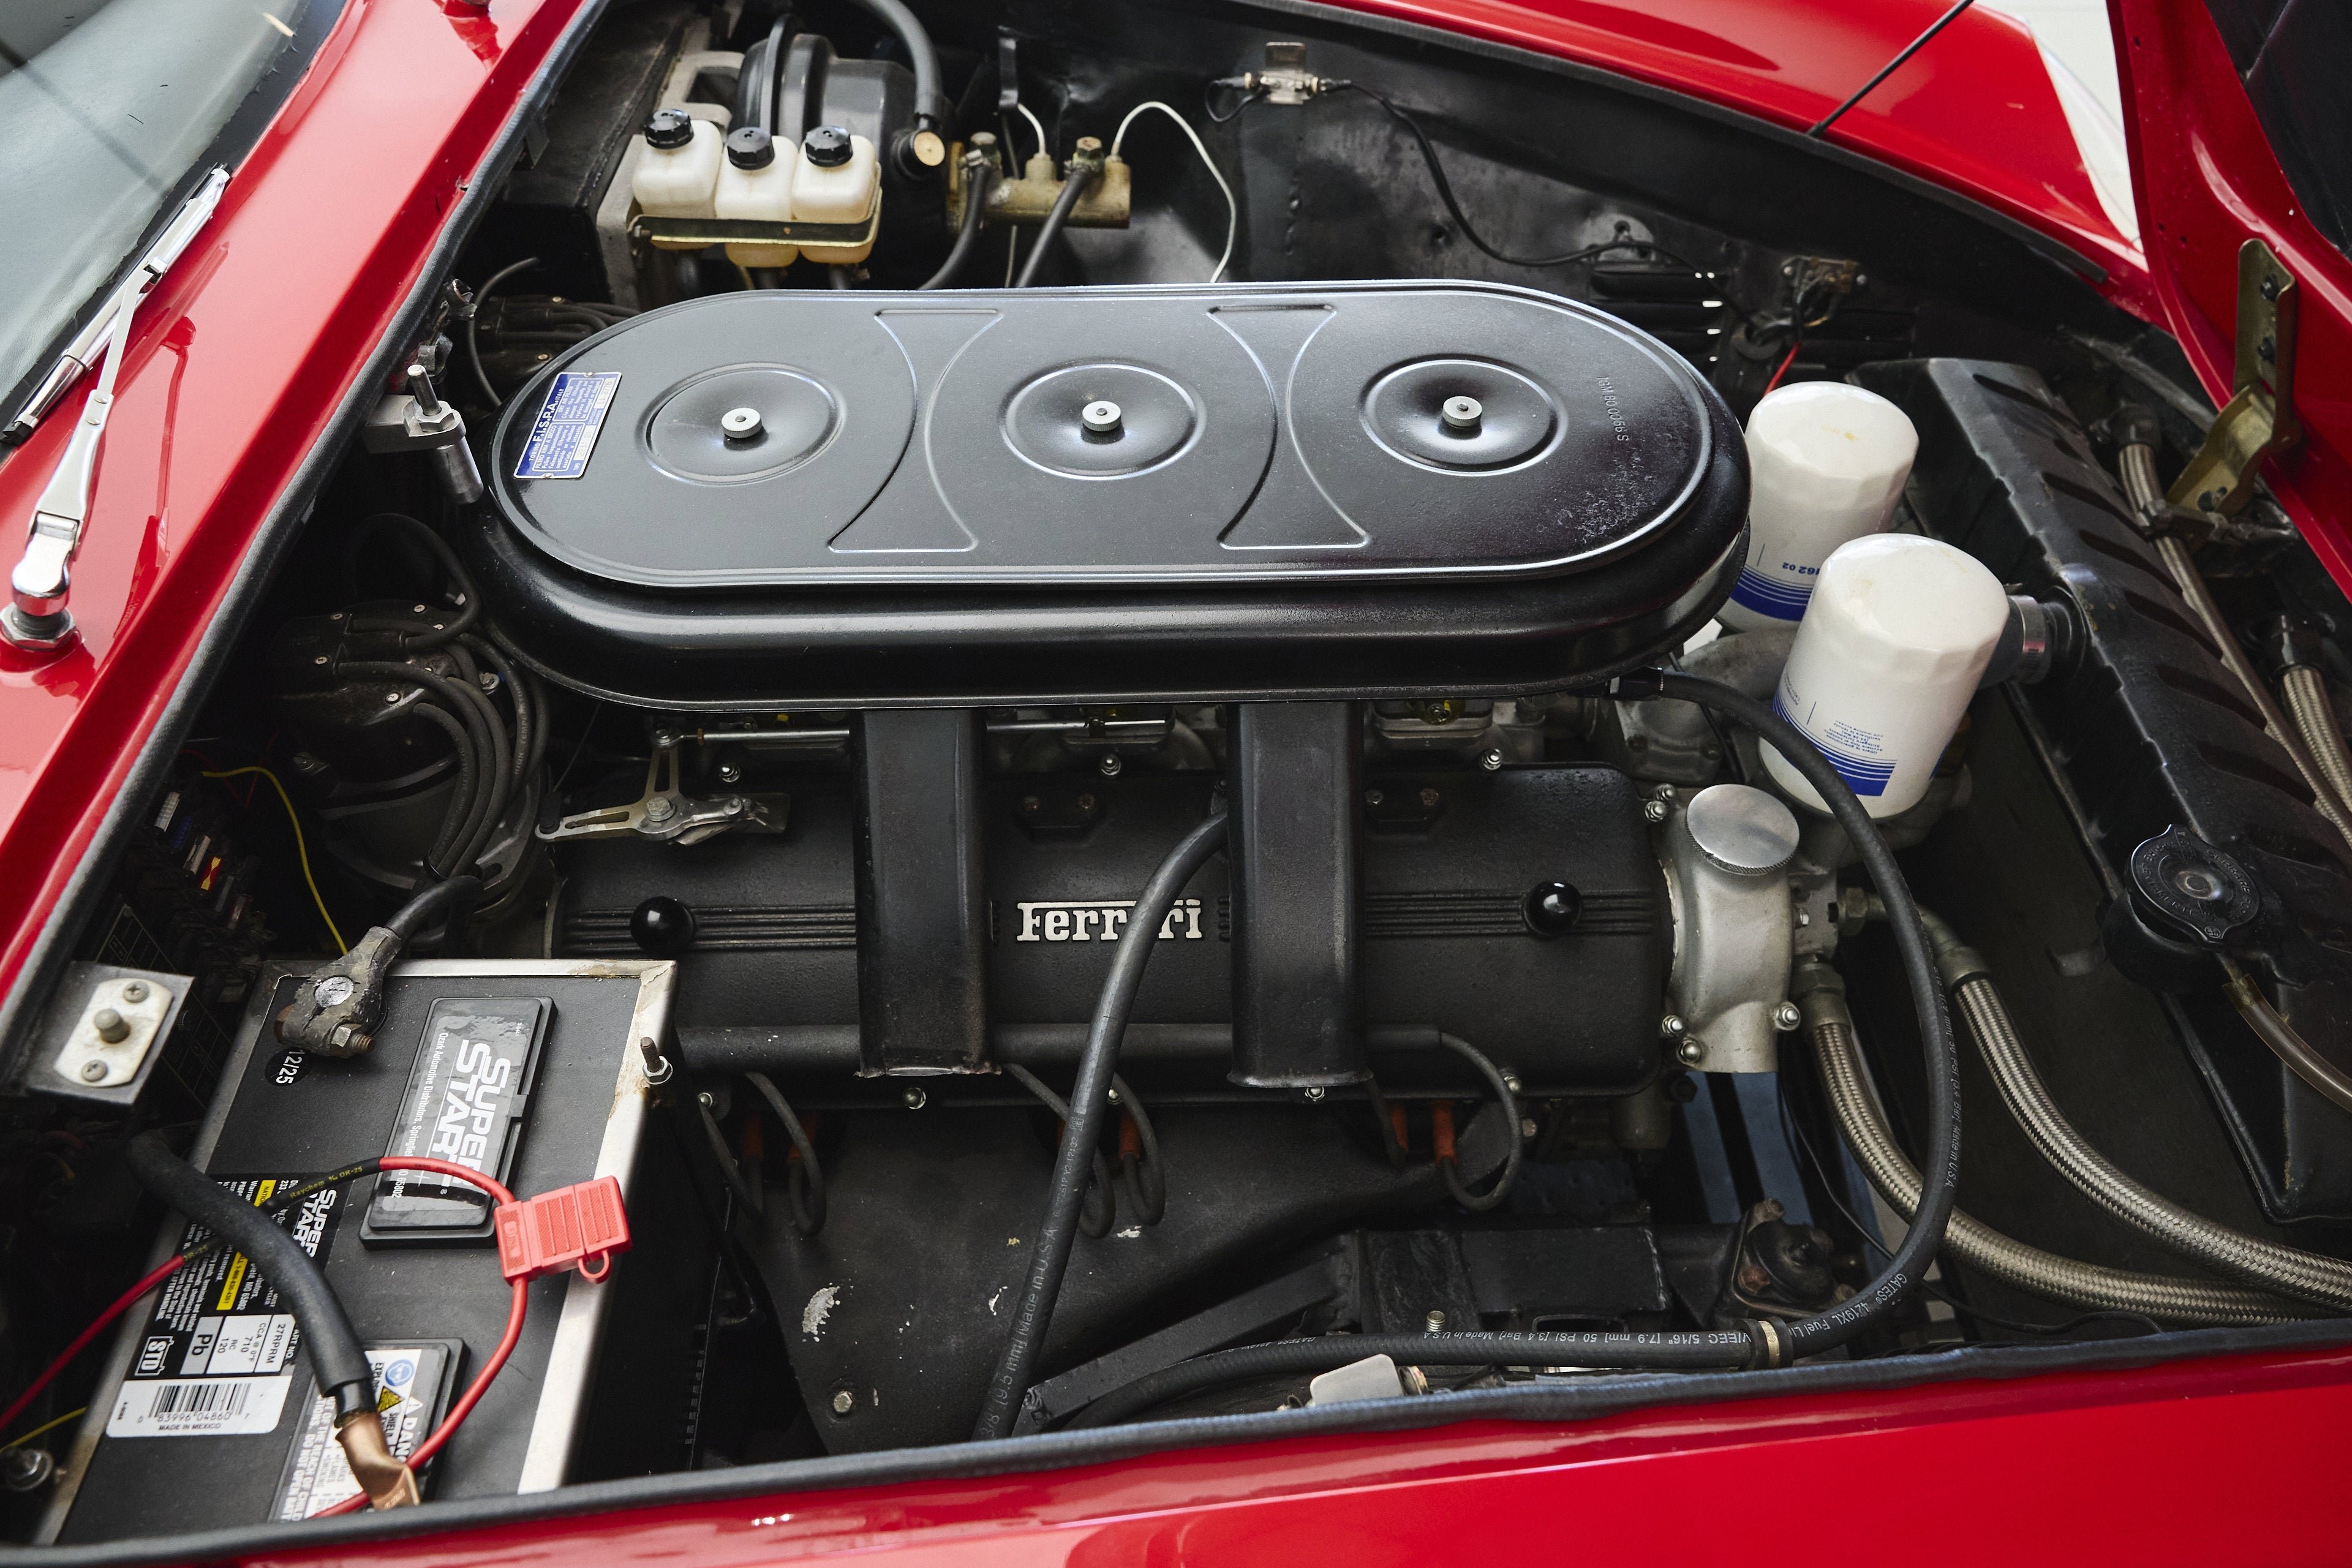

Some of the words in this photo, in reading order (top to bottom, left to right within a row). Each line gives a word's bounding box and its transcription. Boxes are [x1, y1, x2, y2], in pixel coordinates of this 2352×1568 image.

[529, 443, 541, 461] TORINO
[554, 388, 564, 400] ITALY
[1016, 899, 1202, 941] Ferrri
[434, 1033, 448, 1049] Ozark
[276, 1049, 305, 1084] 12/25
[424, 1050, 443, 1084] Automotive
[412, 1085, 432, 1124] Distributors,
[455, 1057, 511, 1186] SUPER
[402, 1125, 421, 1156] Springfiel
[278, 1180, 288, 1189] 233
[391, 1177, 406, 1197] 65802
[214, 1254, 231, 1282] removed.
[243, 1282, 254, 1291] MO
[236, 1292, 250, 1310] 65802
[269, 1293, 278, 1306] MUST
[192, 1303, 202, 1313] and
[255, 1322, 266, 1338] CCA
[1804, 1319, 1830, 1335] Fuel
[265, 1324, 285, 1363] 27RPRM
[1465, 1332, 1493, 1340] Made
[1499, 1330, 1521, 1341] Bar]
[1528, 1332, 1550, 1341] [3.4
[1555, 1333, 1576, 1342] PSI
[1583, 1333, 1597, 1343] 50
[1604, 1333, 1630, 1343] mm]
[1638, 1333, 1660, 1344] [7.9
[1668, 1333, 1700, 1344] 5/16"
[190, 1333, 214, 1355] Pb
[216, 1337, 229, 1353] 120
[228, 1339, 238, 1350] RC
[240, 1336, 253, 1352] 710
[140, 1341, 164, 1371] STD
[157, 1412, 194, 1423] 83996
[195, 1410, 233, 1422] 04860
[192, 1421, 221, 1430] MEXICO
